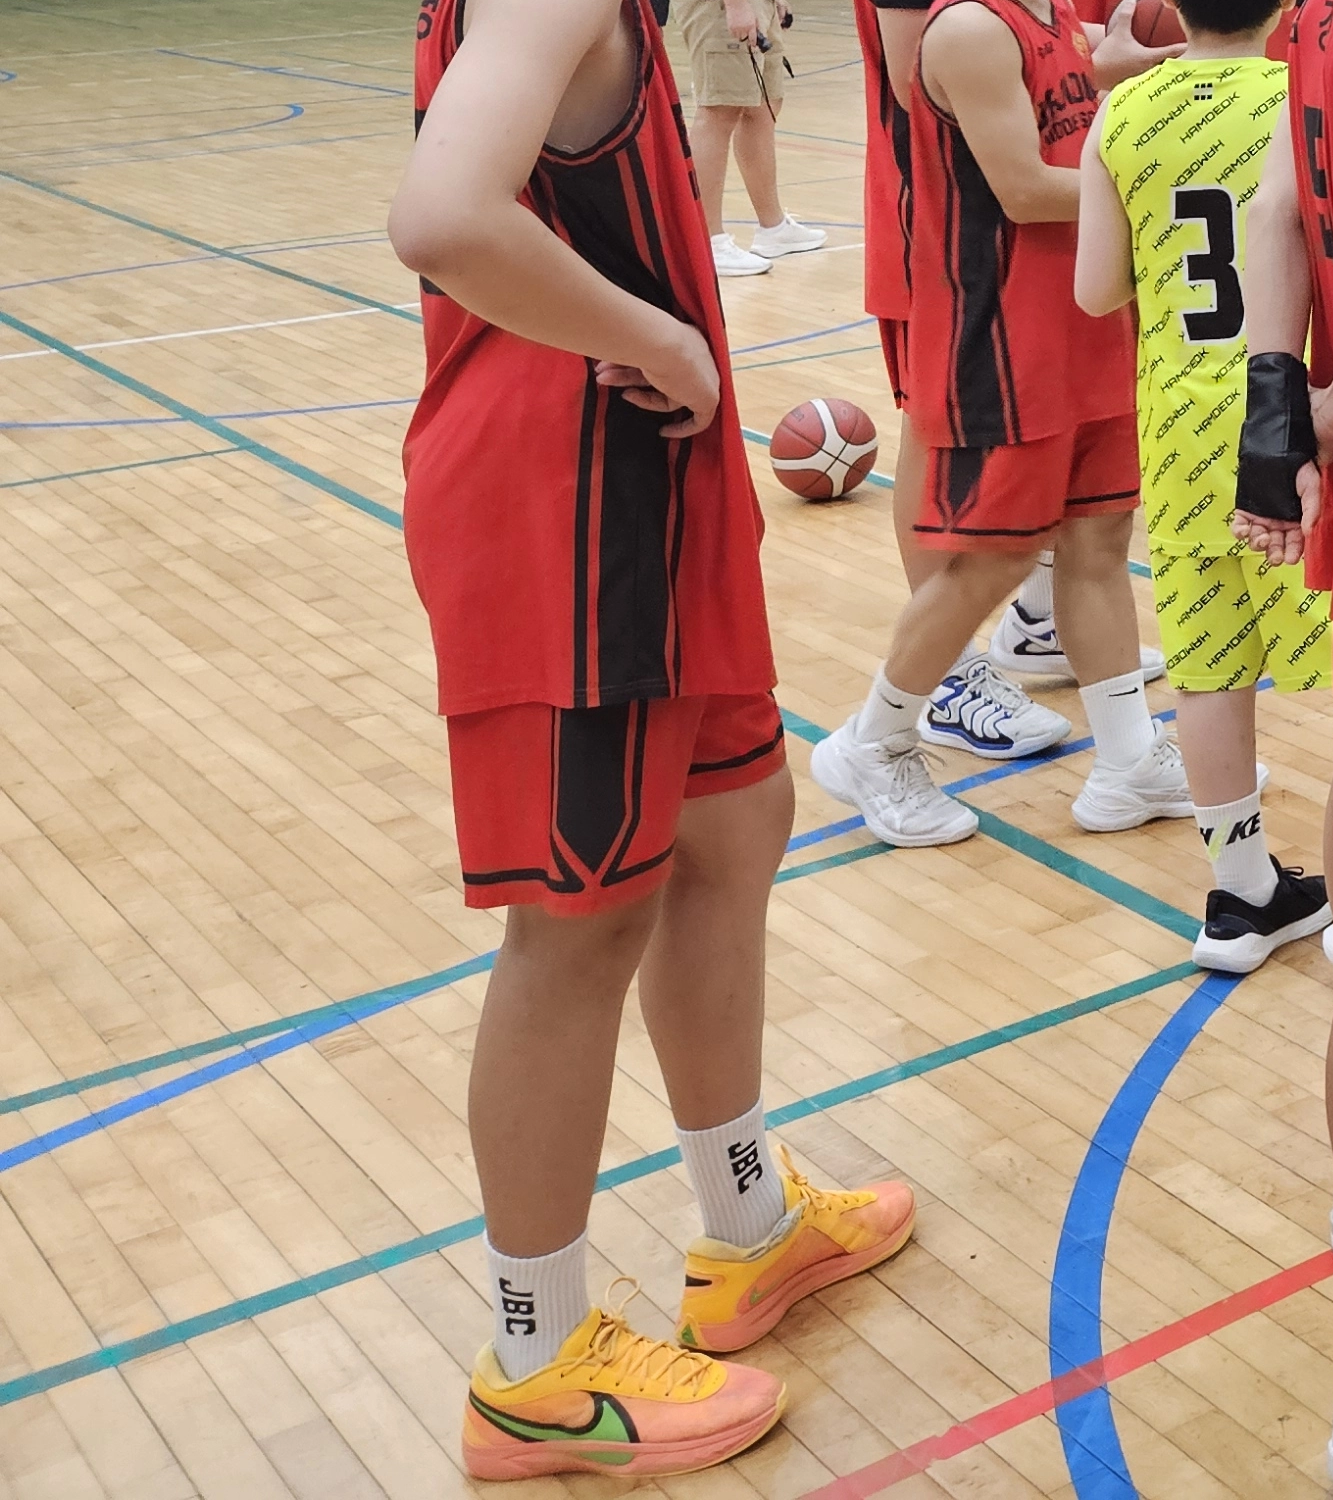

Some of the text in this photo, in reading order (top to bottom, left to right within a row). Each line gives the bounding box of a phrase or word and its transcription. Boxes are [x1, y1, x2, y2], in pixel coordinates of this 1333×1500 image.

[1132, 99, 1191, 151] HAMDEOK
[1179, 91, 1240, 145] HAMDEOK
[1215, 132, 1272, 184] HAMDEOK
[1174, 188, 1245, 341] 3
[1161, 347, 1209, 393] HAMDEOK
[1155, 398, 1195, 442] HAMDEOK
[1193, 389, 1240, 437] HAMDEOK
[1185, 441, 1229, 486] HAMDEOK
[1174, 491, 1217, 535] HAMDEOK
[1177, 580, 1225, 628] HAMDEOK
[1287, 616, 1331, 666] HAMDEOK
[727, 1138, 764, 1195] JBC
[498, 1277, 537, 1336] JBC
